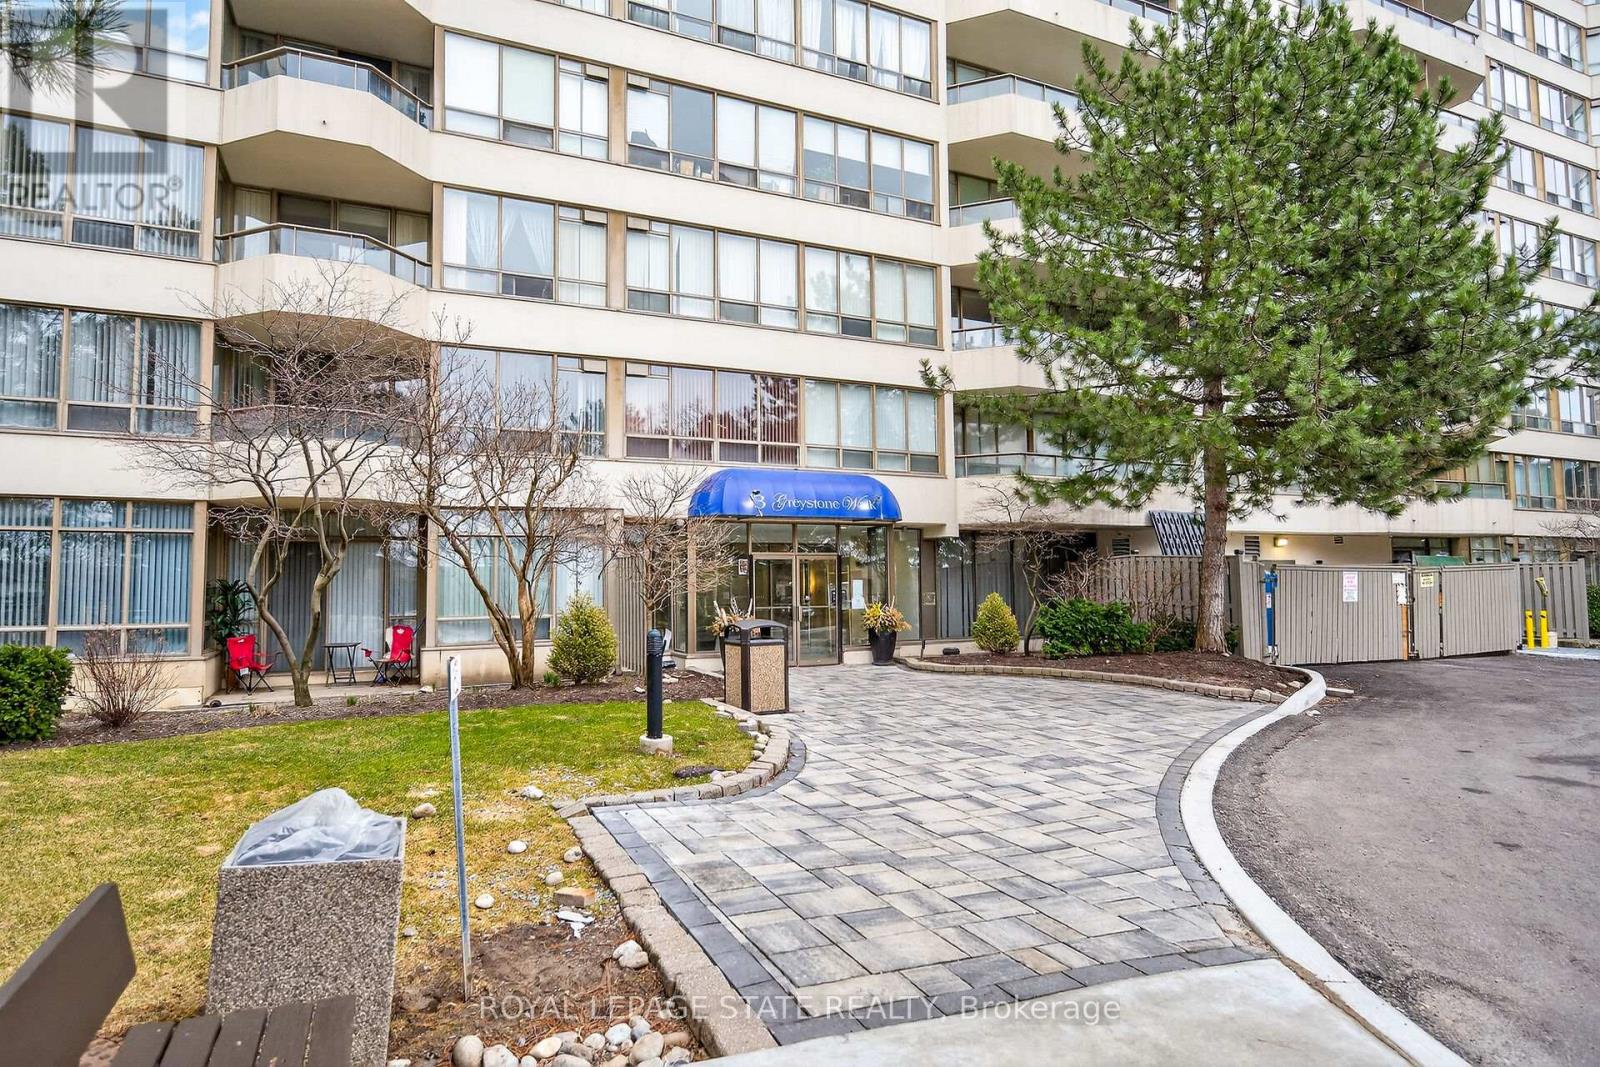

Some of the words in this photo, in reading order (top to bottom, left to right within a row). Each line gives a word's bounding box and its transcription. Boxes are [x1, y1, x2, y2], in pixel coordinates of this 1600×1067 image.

[753, 494, 767, 509] 3
[771, 491, 841, 512] Greystone
[841, 495, 878, 511] Wk
